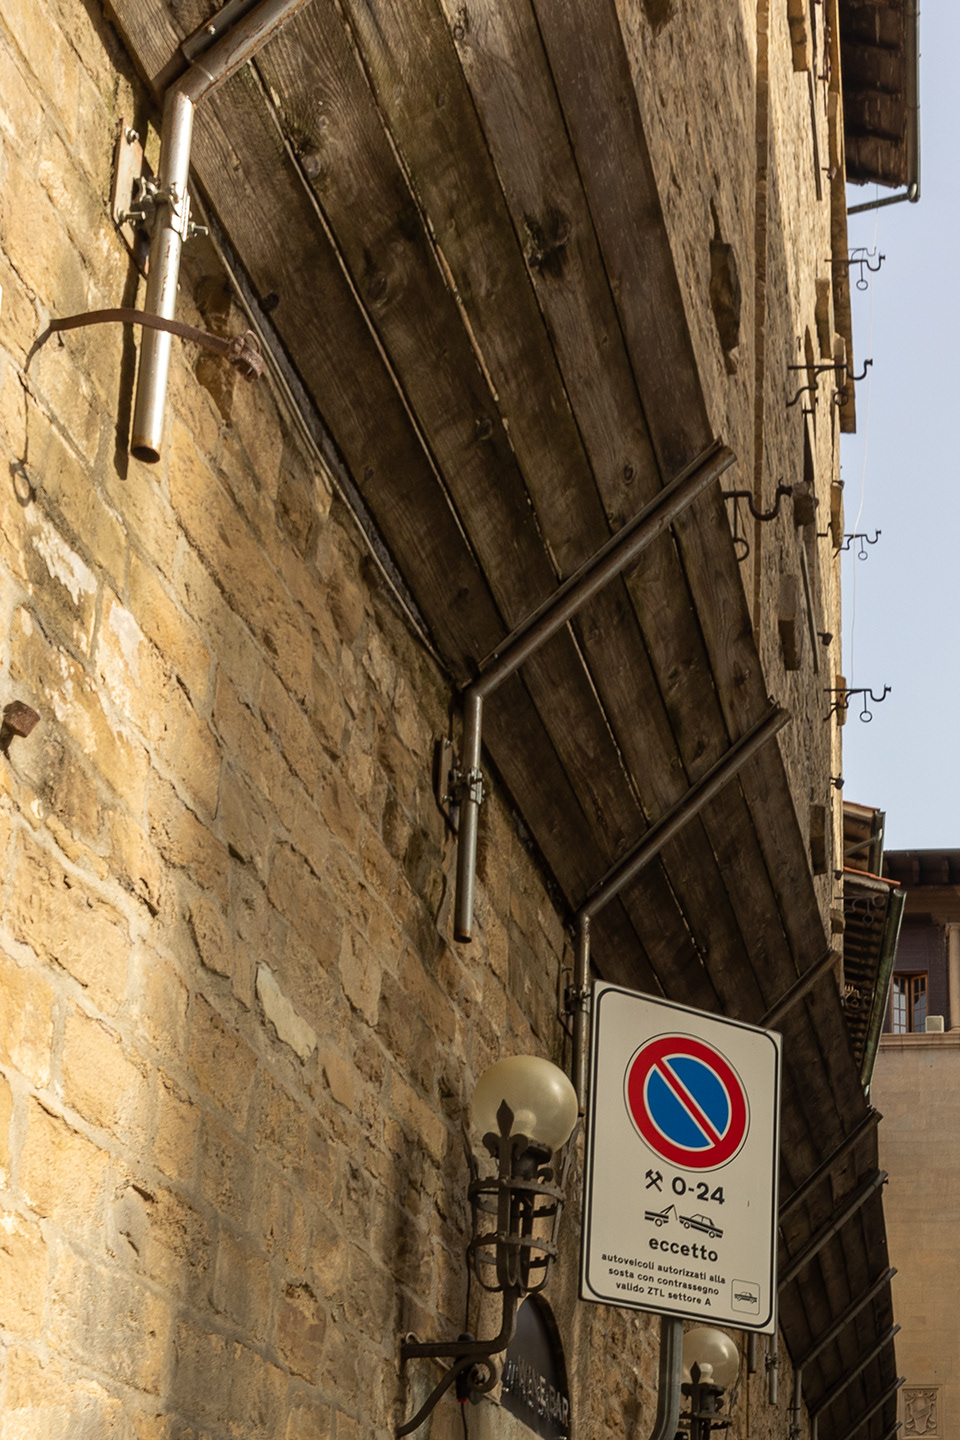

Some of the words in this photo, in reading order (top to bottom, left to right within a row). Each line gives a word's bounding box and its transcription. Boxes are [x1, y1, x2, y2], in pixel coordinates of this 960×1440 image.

[672, 1176, 725, 1205] 0-24
[649, 1238, 718, 1262] eccetto
[602, 1254, 654, 1270] autoveicoli
[657, 1265, 706, 1280] autorizzati
[709, 1275, 725, 1284] alla
[609, 1268, 634, 1279] sosta
[637, 1273, 654, 1283] con
[657, 1278, 719, 1295] contrassegno
[616, 1283, 645, 1293] valido
[648, 1287, 664, 1297] ZTL
[668, 1292, 702, 1304] settore
[705, 1298, 711, 1306] A
